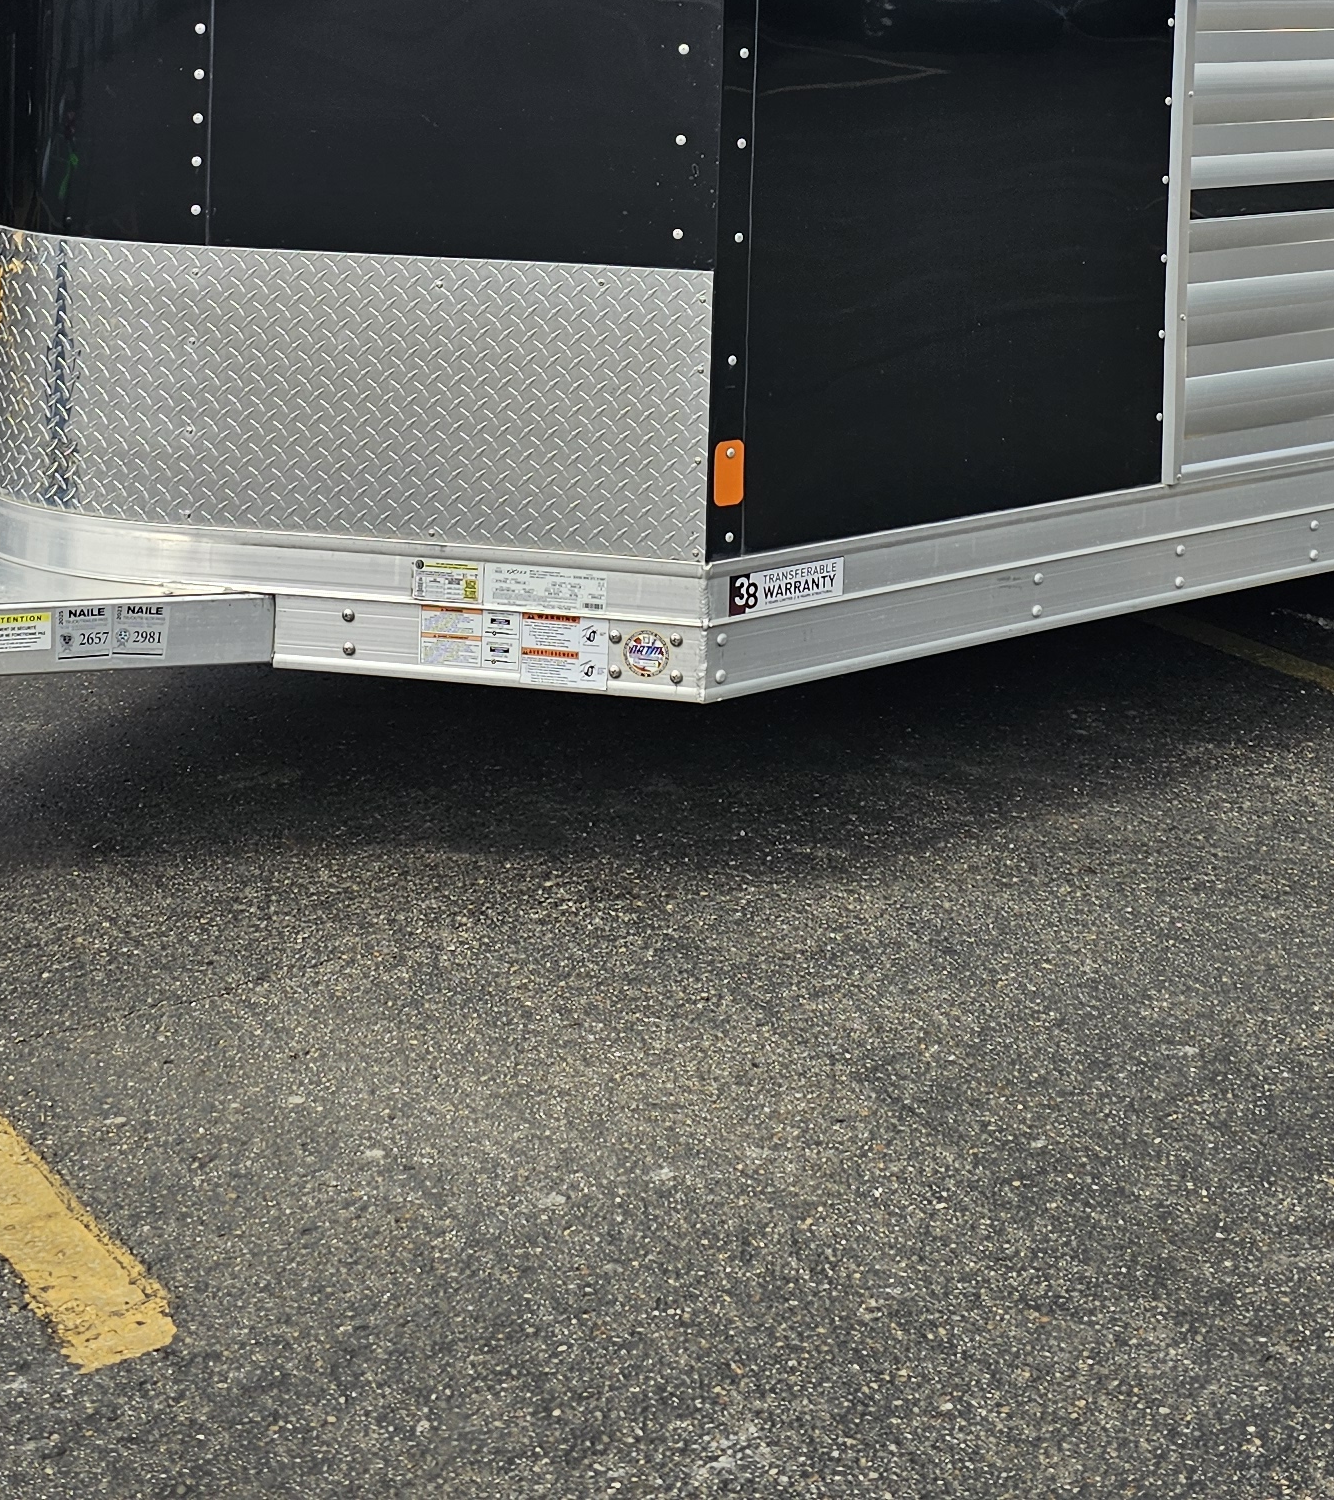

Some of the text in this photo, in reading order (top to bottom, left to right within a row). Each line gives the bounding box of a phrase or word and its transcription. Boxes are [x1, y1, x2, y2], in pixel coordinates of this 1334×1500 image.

[763, 562, 837, 585] TRANSFERABLE
[734, 576, 759, 609] 38
[763, 573, 836, 600] WARRANTY
[68, 607, 105, 618] NAILE
[127, 606, 164, 616] NAILE
[537, 614, 577, 622] WARNING
[79, 631, 109, 646] 2657
[132, 630, 162, 644] 2981
